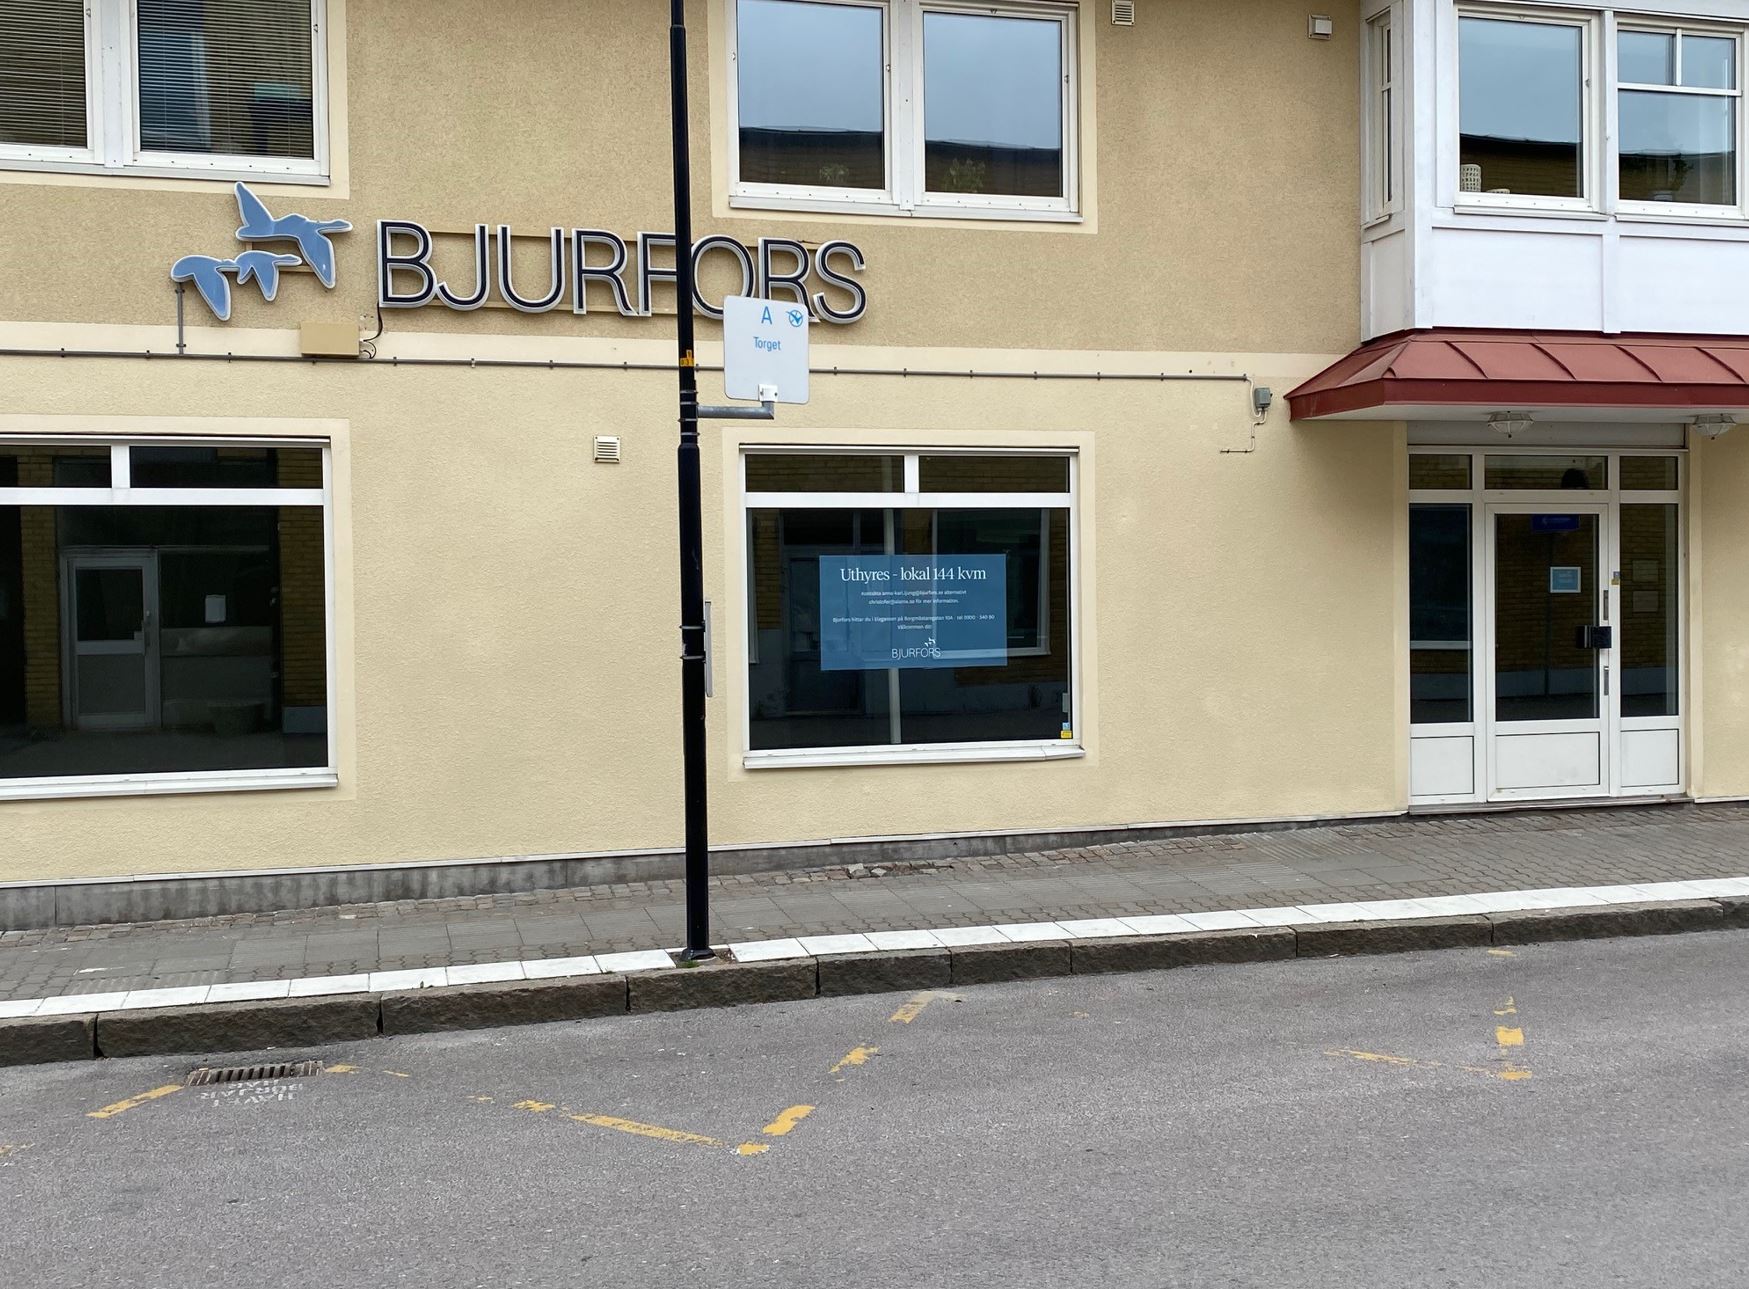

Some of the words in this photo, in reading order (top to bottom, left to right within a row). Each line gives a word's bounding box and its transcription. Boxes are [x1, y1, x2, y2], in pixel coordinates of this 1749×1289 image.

[377, 219, 866, 324] BJURFORS
[761, 306, 773, 325] A
[753, 336, 781, 352] Torget
[840, 567, 890, 584] Uthyres
[900, 566, 930, 581] lokal
[933, 567, 955, 580] 144
[957, 566, 986, 580] kvm
[891, 647, 941, 660] BJURFORS
